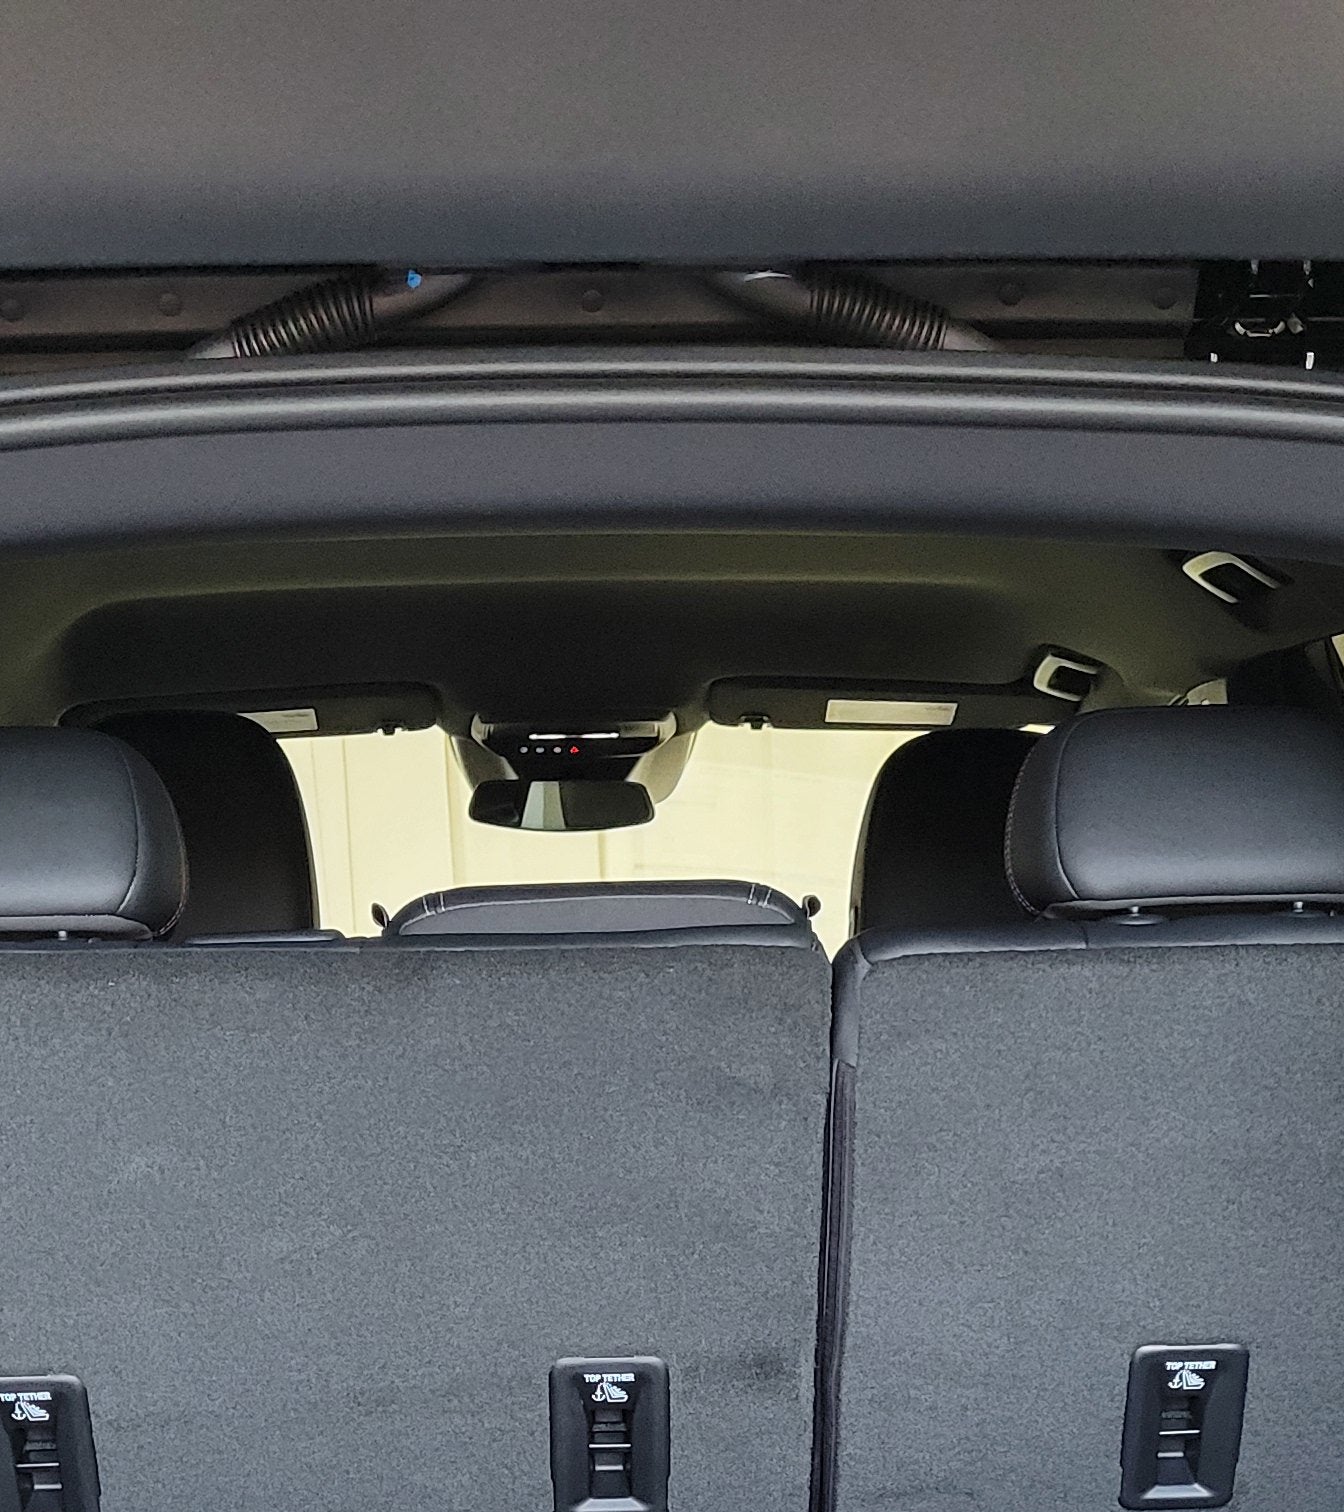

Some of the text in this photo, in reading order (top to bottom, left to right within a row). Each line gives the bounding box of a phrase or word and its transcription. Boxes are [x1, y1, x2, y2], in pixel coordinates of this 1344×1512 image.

[1166, 1360, 1217, 1371] TOP TETHER
[583, 1372, 636, 1383] TOP TETHER
